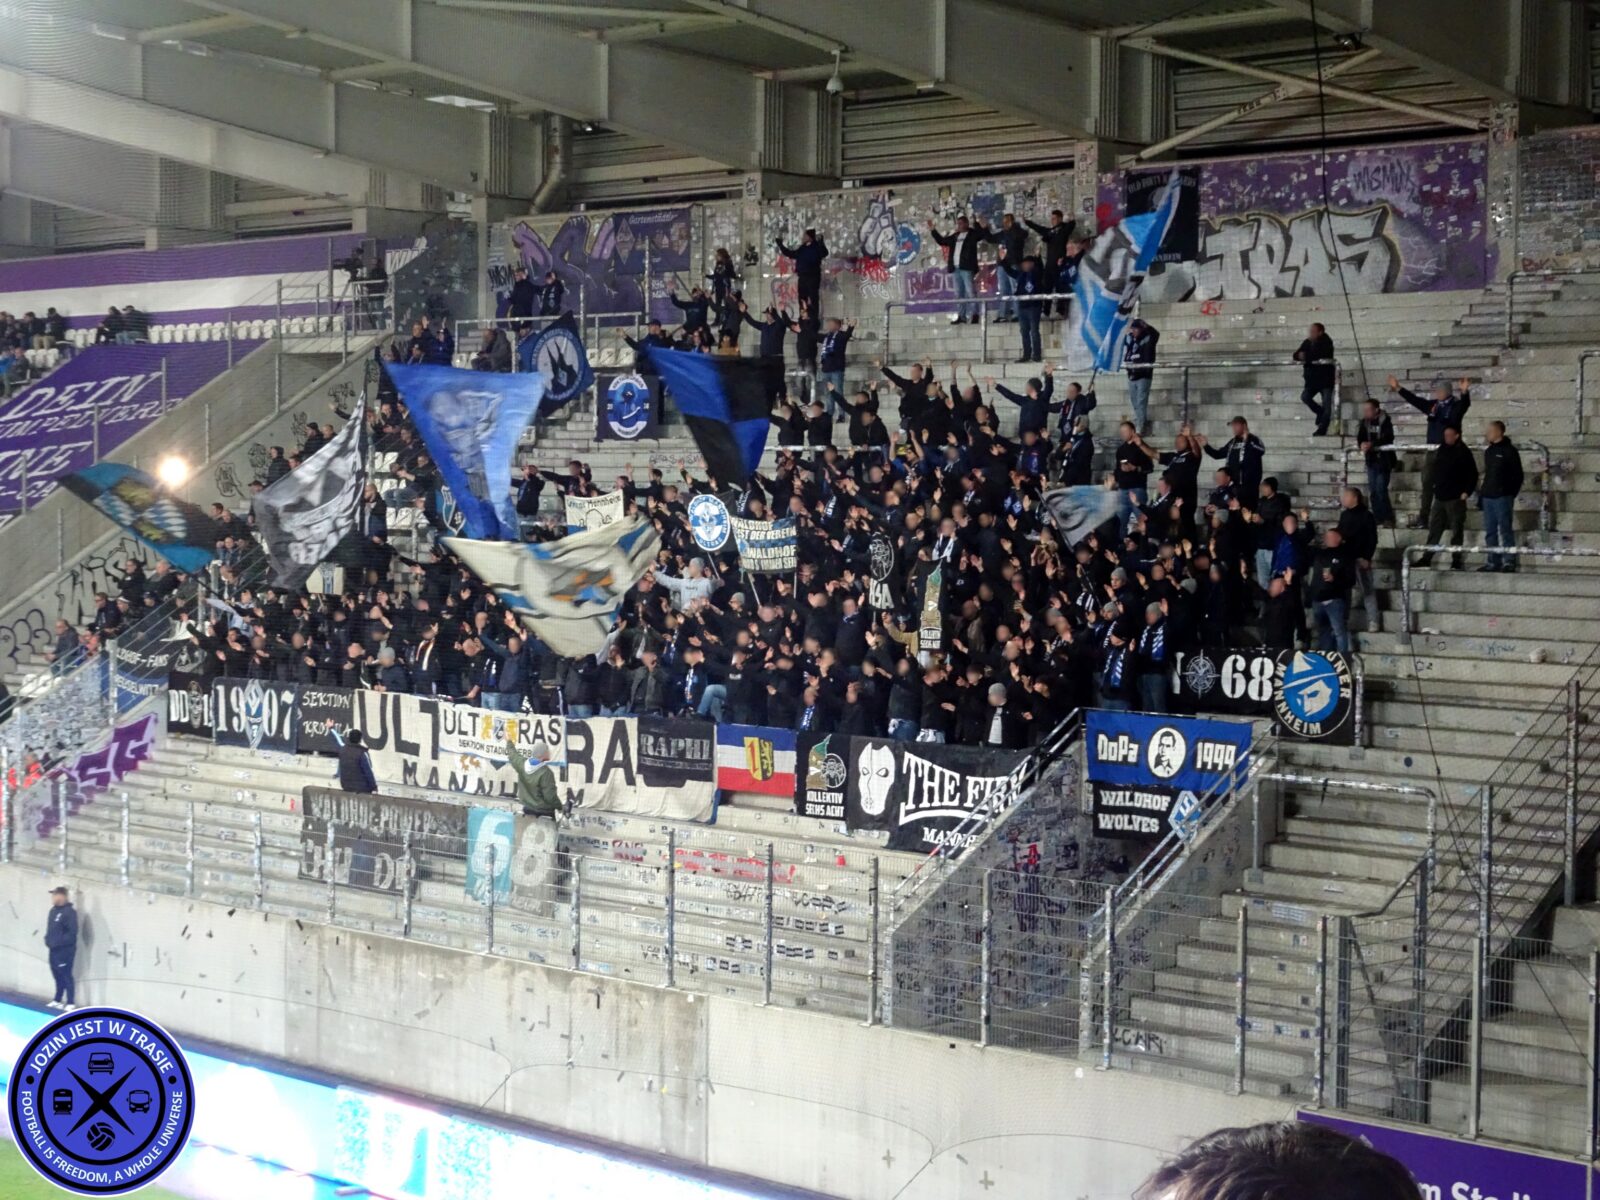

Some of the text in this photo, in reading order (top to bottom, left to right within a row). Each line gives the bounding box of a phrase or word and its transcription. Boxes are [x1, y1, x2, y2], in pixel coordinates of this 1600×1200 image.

[0, 372, 162, 421] DEIN
[745, 544, 797, 559] WALDHOF
[302, 690, 352, 709] SEKTION
[1274, 662, 1321, 735] MANNHEIM
[1097, 733, 1139, 763] DoPa
[902, 751, 961, 810] THE
[806, 790, 843, 805] KOLLEKTIV
[1100, 789, 1171, 812] WALDHOF
[805, 802, 845, 818] SECHS ACHT
[1098, 812, 1160, 833] WOLVES
